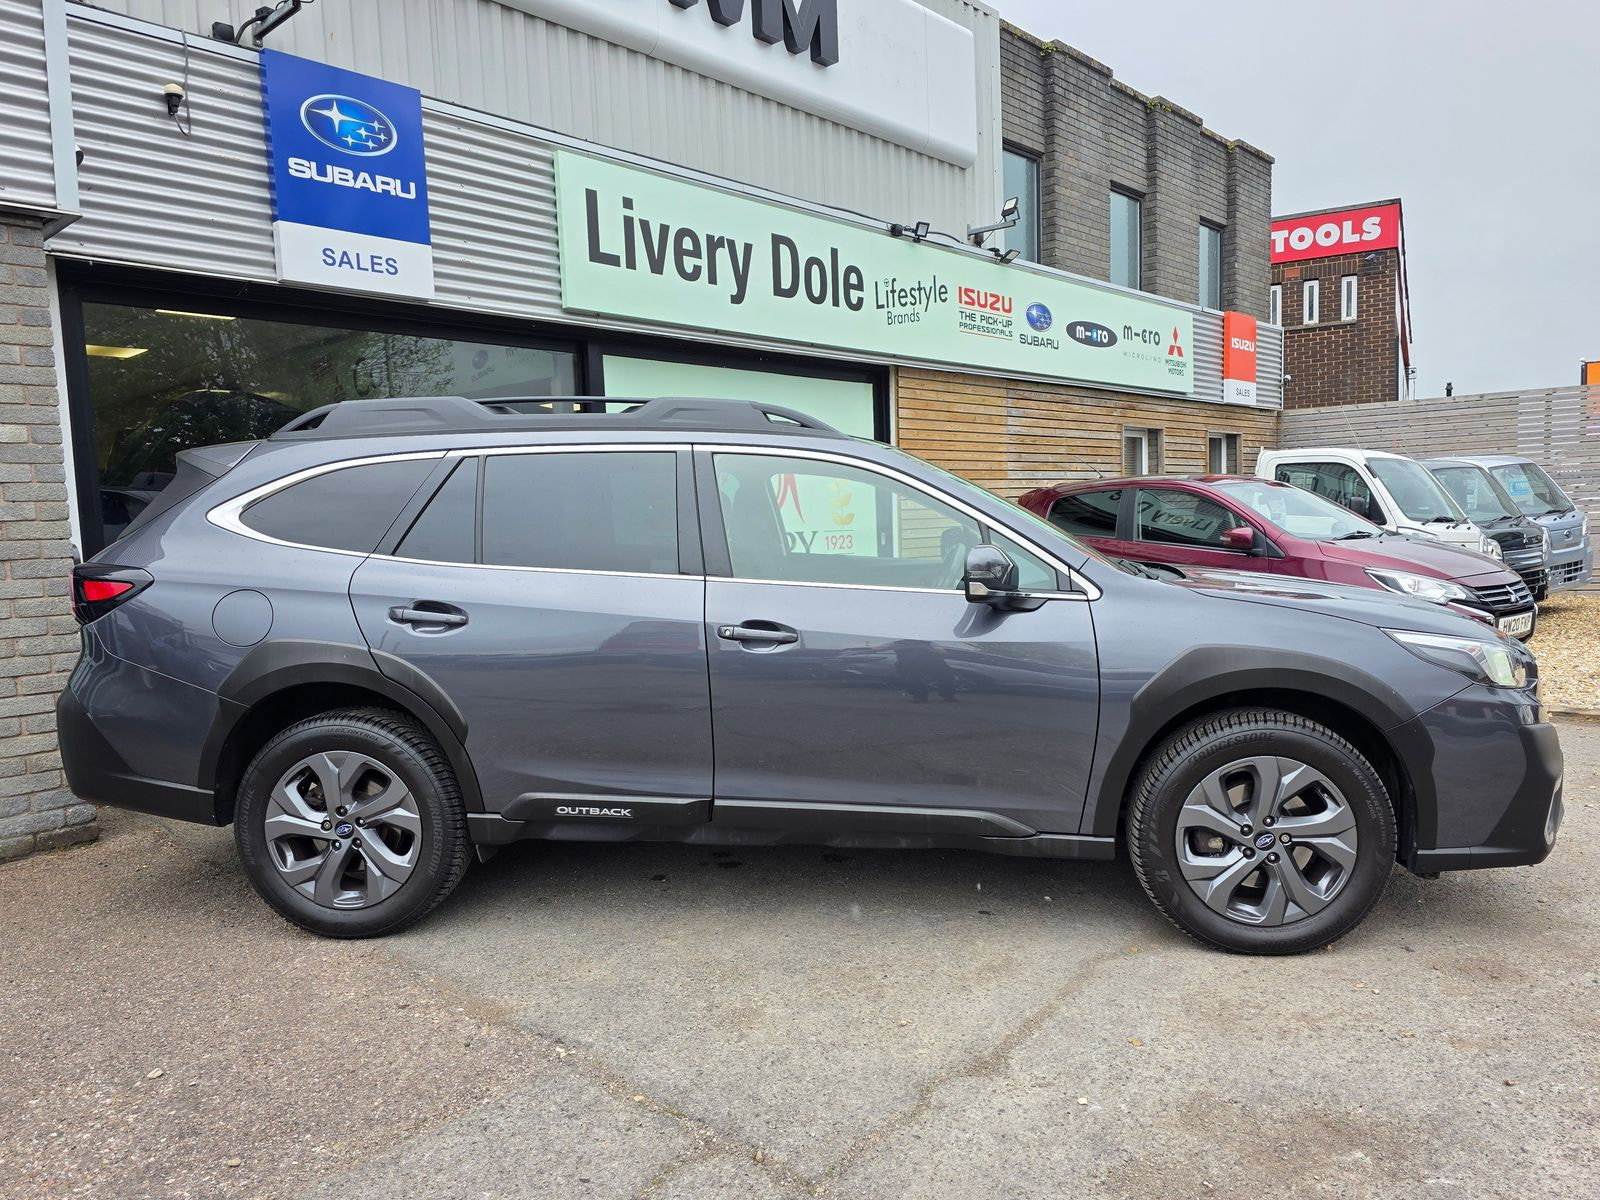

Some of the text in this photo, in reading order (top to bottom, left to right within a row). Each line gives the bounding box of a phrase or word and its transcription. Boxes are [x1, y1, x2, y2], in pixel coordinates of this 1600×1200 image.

[288, 157, 416, 200] SUBARU
[1271, 216, 1382, 253] TOOLS
[585, 187, 865, 311] Livery Dole
[322, 247, 399, 276] SALES
[874, 275, 949, 312] Lifestyle
[958, 286, 1013, 314] ISUZU
[886, 310, 921, 326] Brands
[959, 310, 1013, 329] THE PICK-UP
[959, 321, 1013, 338] PROFESSIONALS
[1019, 333, 1060, 350] SUBARU
[1231, 337, 1255, 353] ISUZU
[1235, 387, 1251, 398] SALES
[825, 534, 853, 550] 1923
[556, 806, 632, 817] OUTBACK
